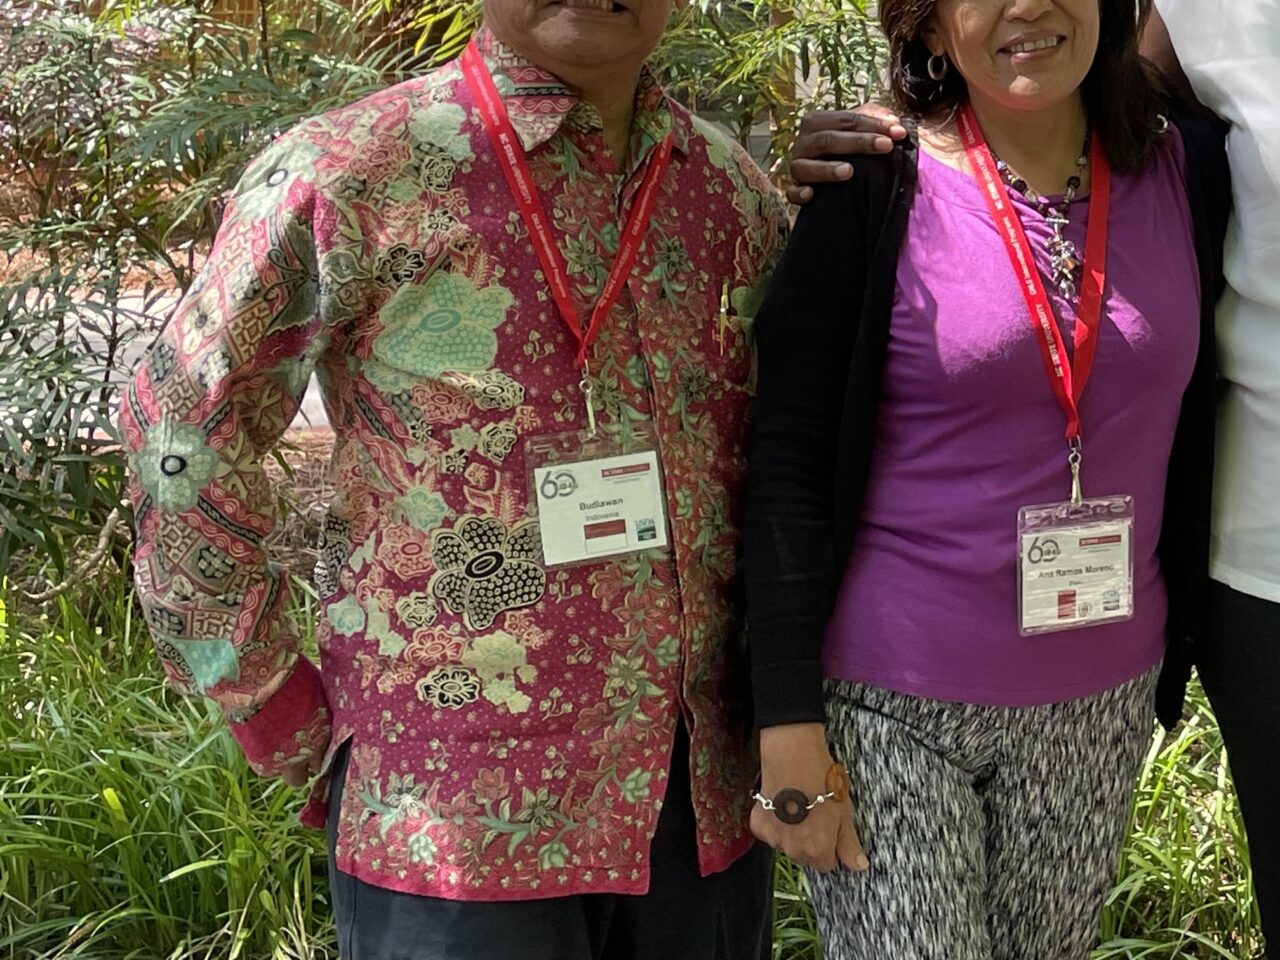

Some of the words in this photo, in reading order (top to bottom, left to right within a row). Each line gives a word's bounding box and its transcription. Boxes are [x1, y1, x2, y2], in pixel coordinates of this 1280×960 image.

[499, 133, 508, 144] NC
[504, 144, 516, 165] STATE
[512, 166, 531, 203] UNIVERSITY
[532, 214, 542, 229] CALS
[579, 498, 624, 511] Budiawan
